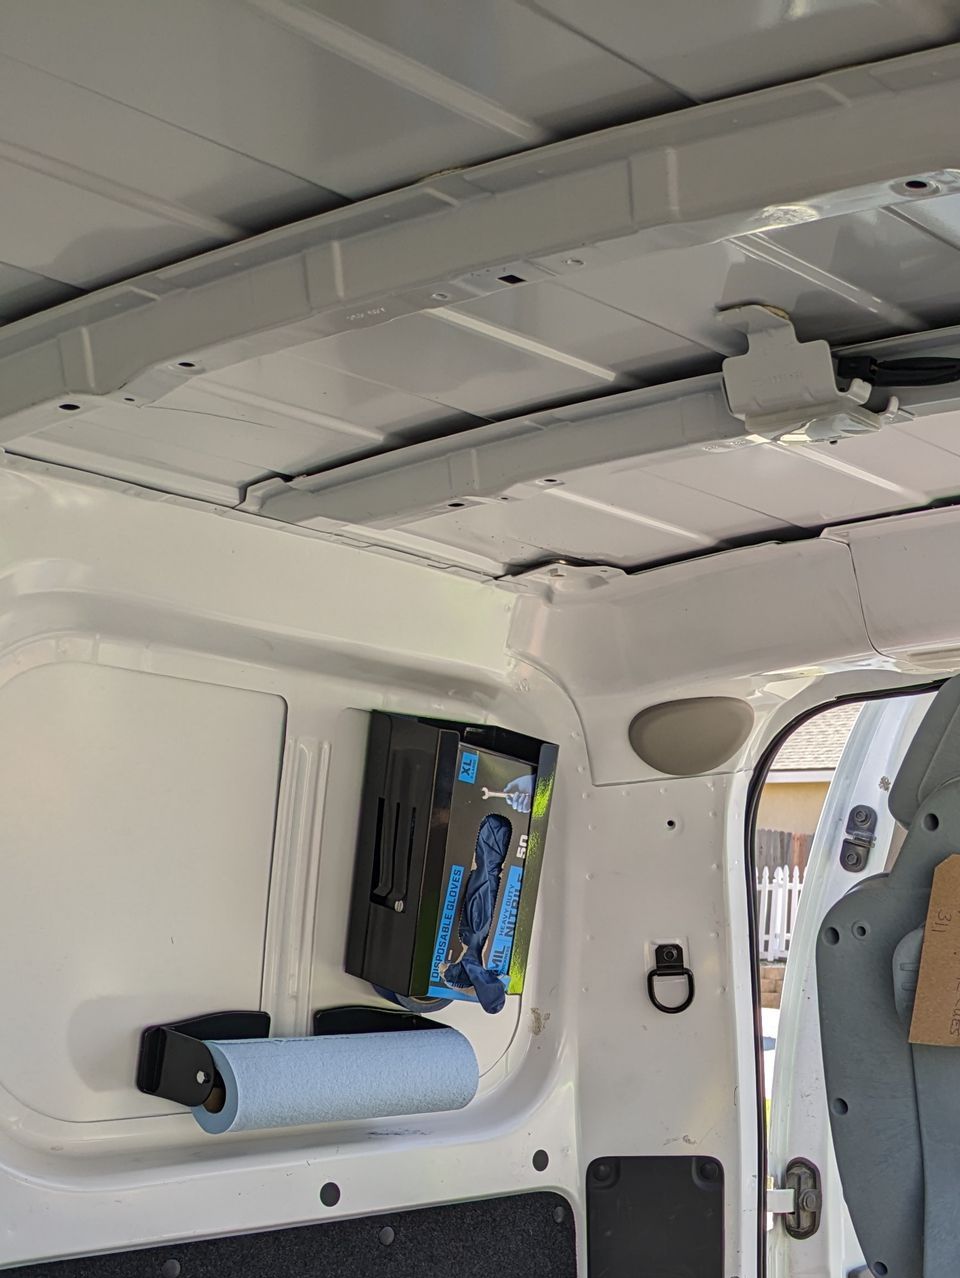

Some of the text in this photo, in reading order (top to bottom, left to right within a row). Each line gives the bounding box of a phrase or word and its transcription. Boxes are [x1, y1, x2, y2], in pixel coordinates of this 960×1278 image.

[461, 759, 473, 777] XL
[431, 869, 462, 980] DISPOSABLE GLOVES
[498, 883, 515, 936] HEAVY DUTY
